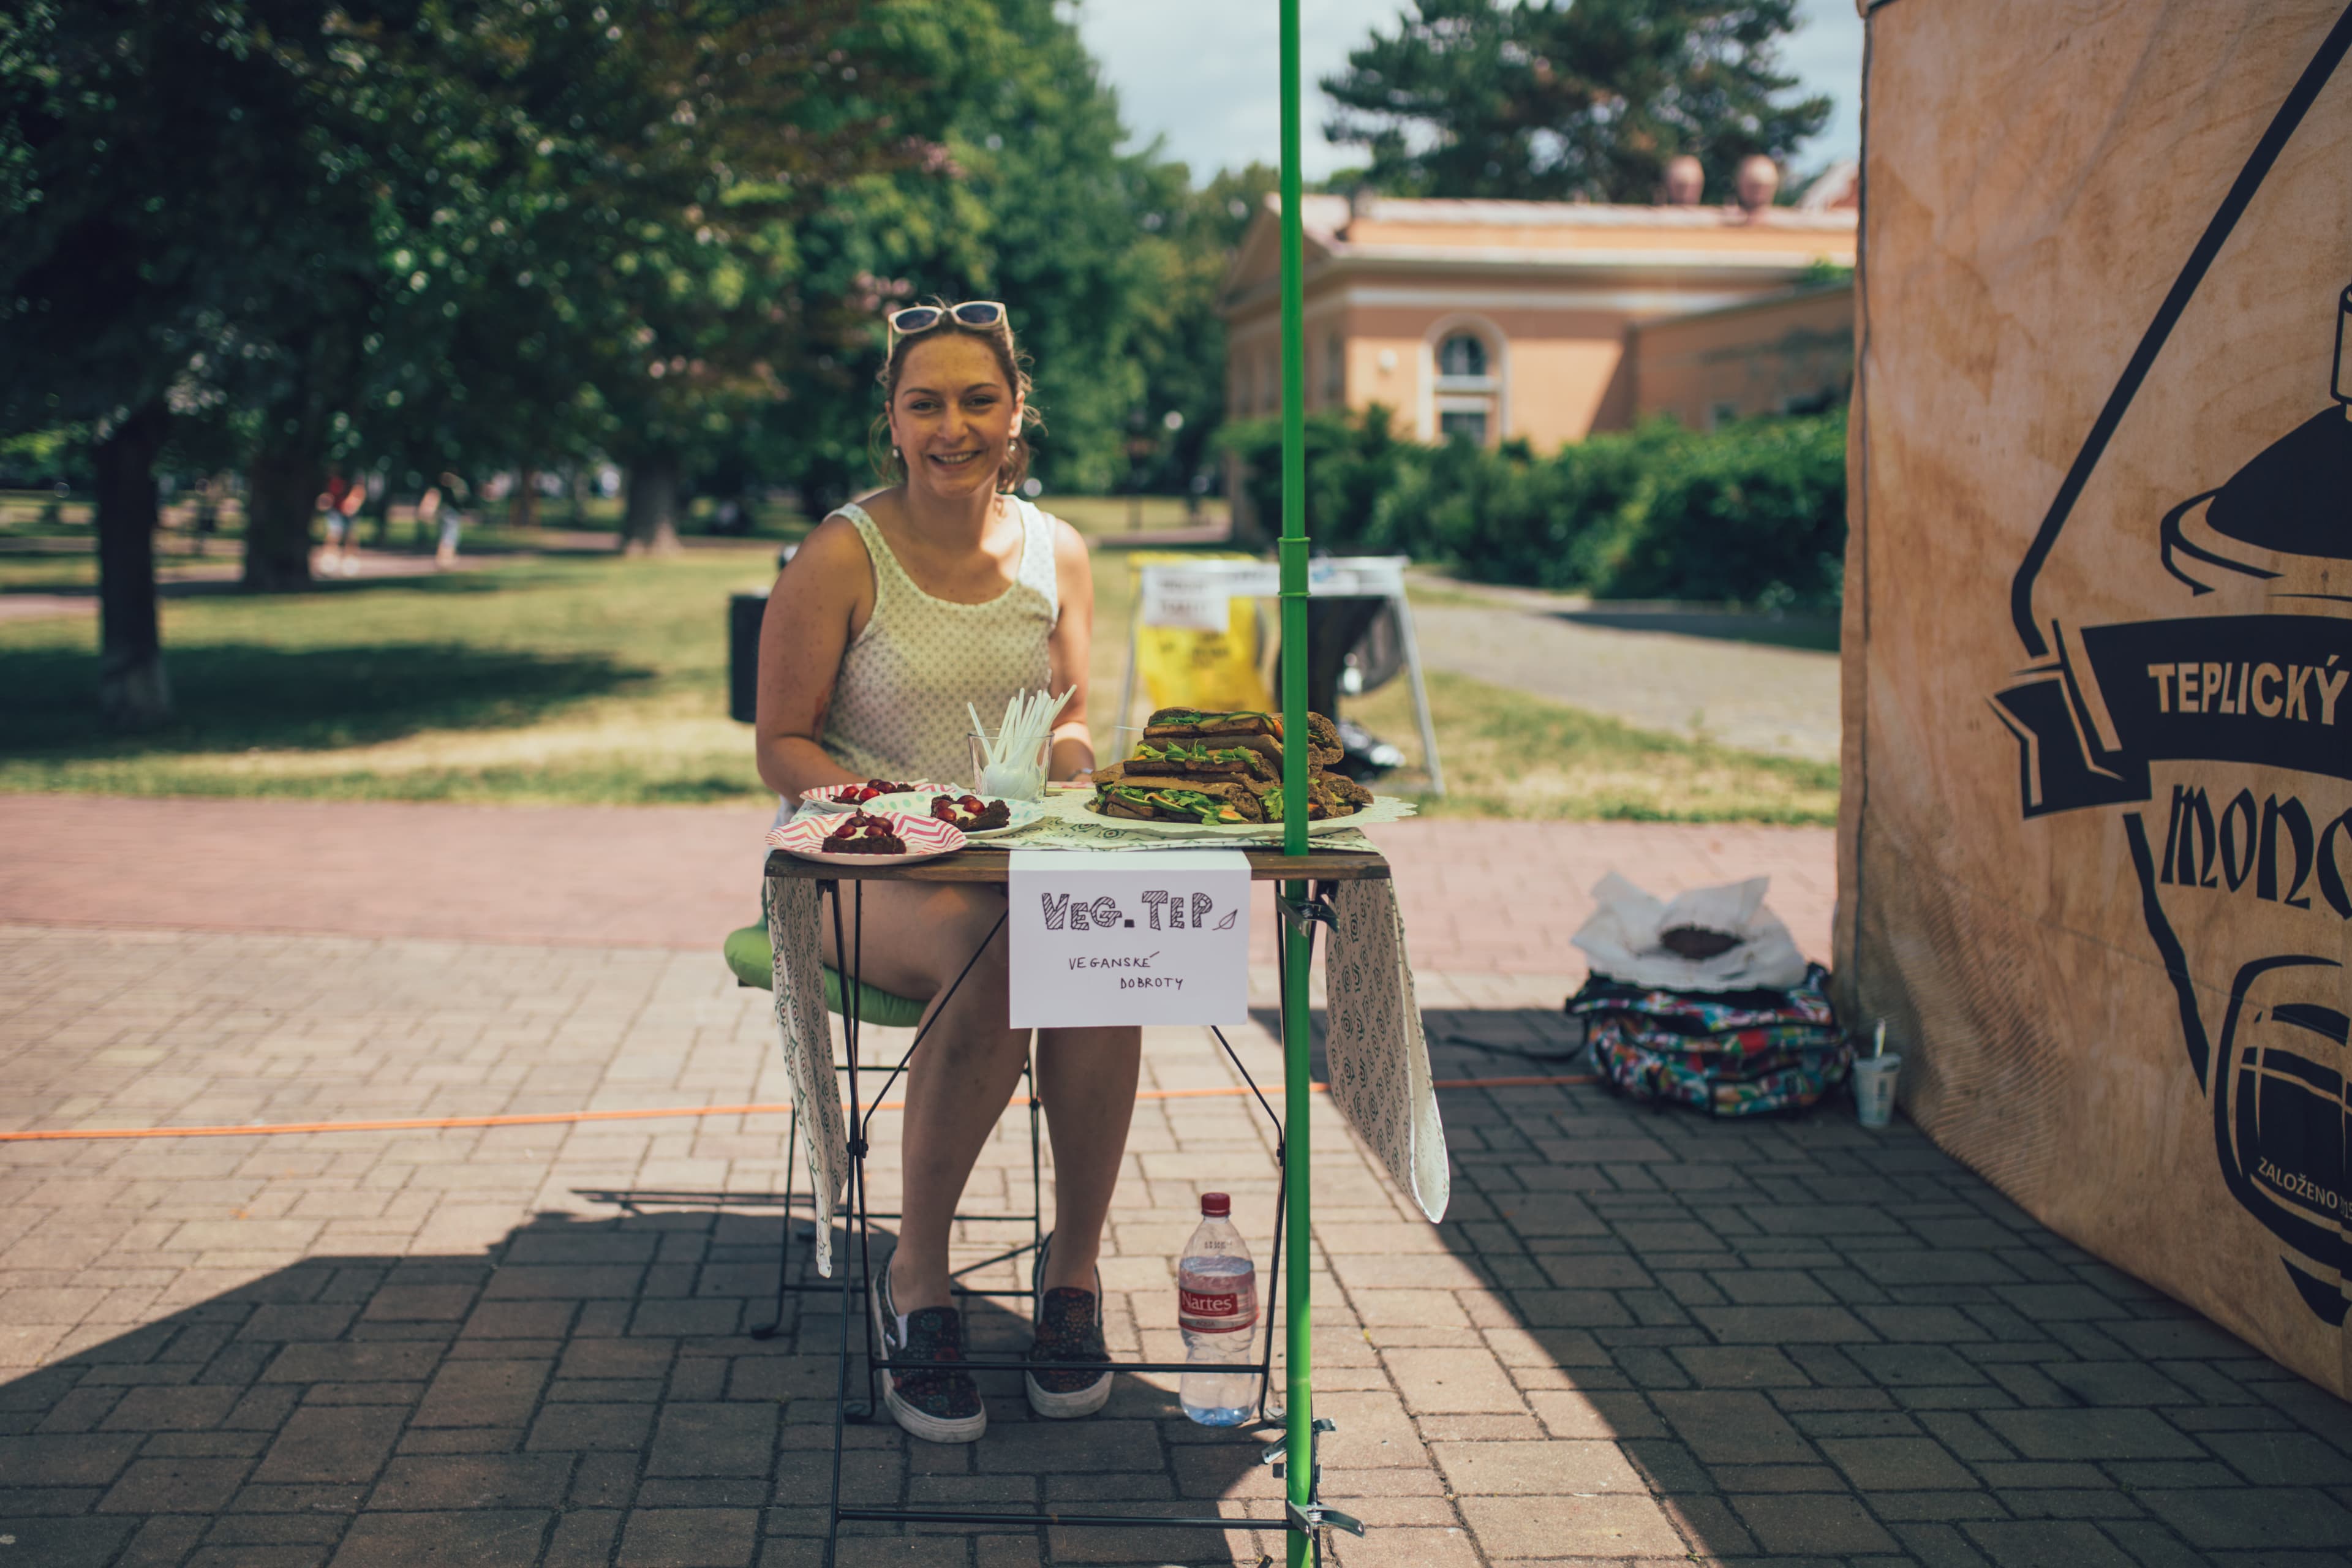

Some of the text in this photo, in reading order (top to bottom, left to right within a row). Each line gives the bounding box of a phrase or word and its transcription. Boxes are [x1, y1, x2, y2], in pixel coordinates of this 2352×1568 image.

[2147, 655, 2350, 725] TEPLICKÝ
[1069, 951, 1160, 970] VEGANSKÉ
[1120, 978, 1183, 990] DOBROTY
[2258, 1156, 2339, 1209] ZALOŽENO
